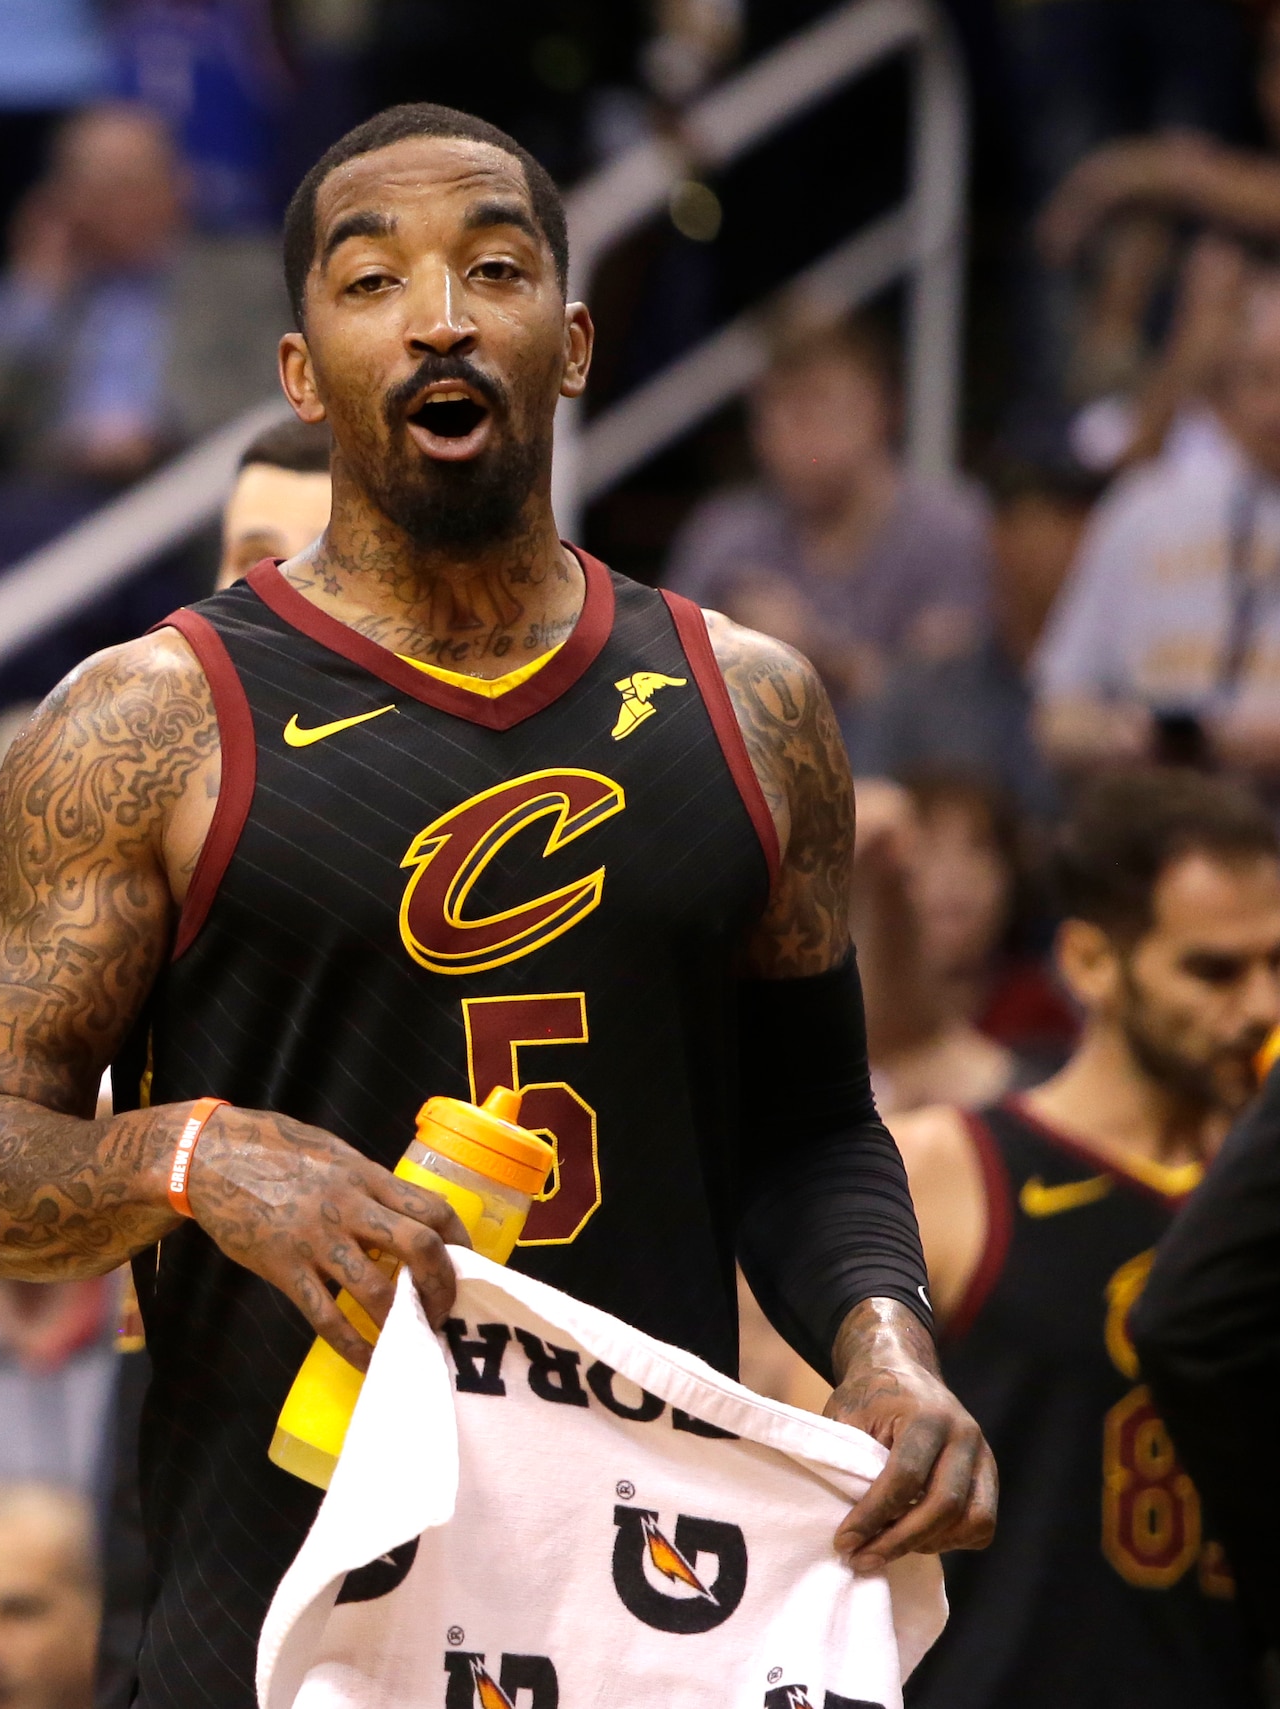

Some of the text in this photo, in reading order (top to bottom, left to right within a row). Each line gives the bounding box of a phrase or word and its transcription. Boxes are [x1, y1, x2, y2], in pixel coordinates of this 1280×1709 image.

[399, 767, 626, 976] C
[170, 1117, 202, 1193] CREW ONLY
[461, 992, 602, 1247] 5
[612, 1504, 748, 1635] G
